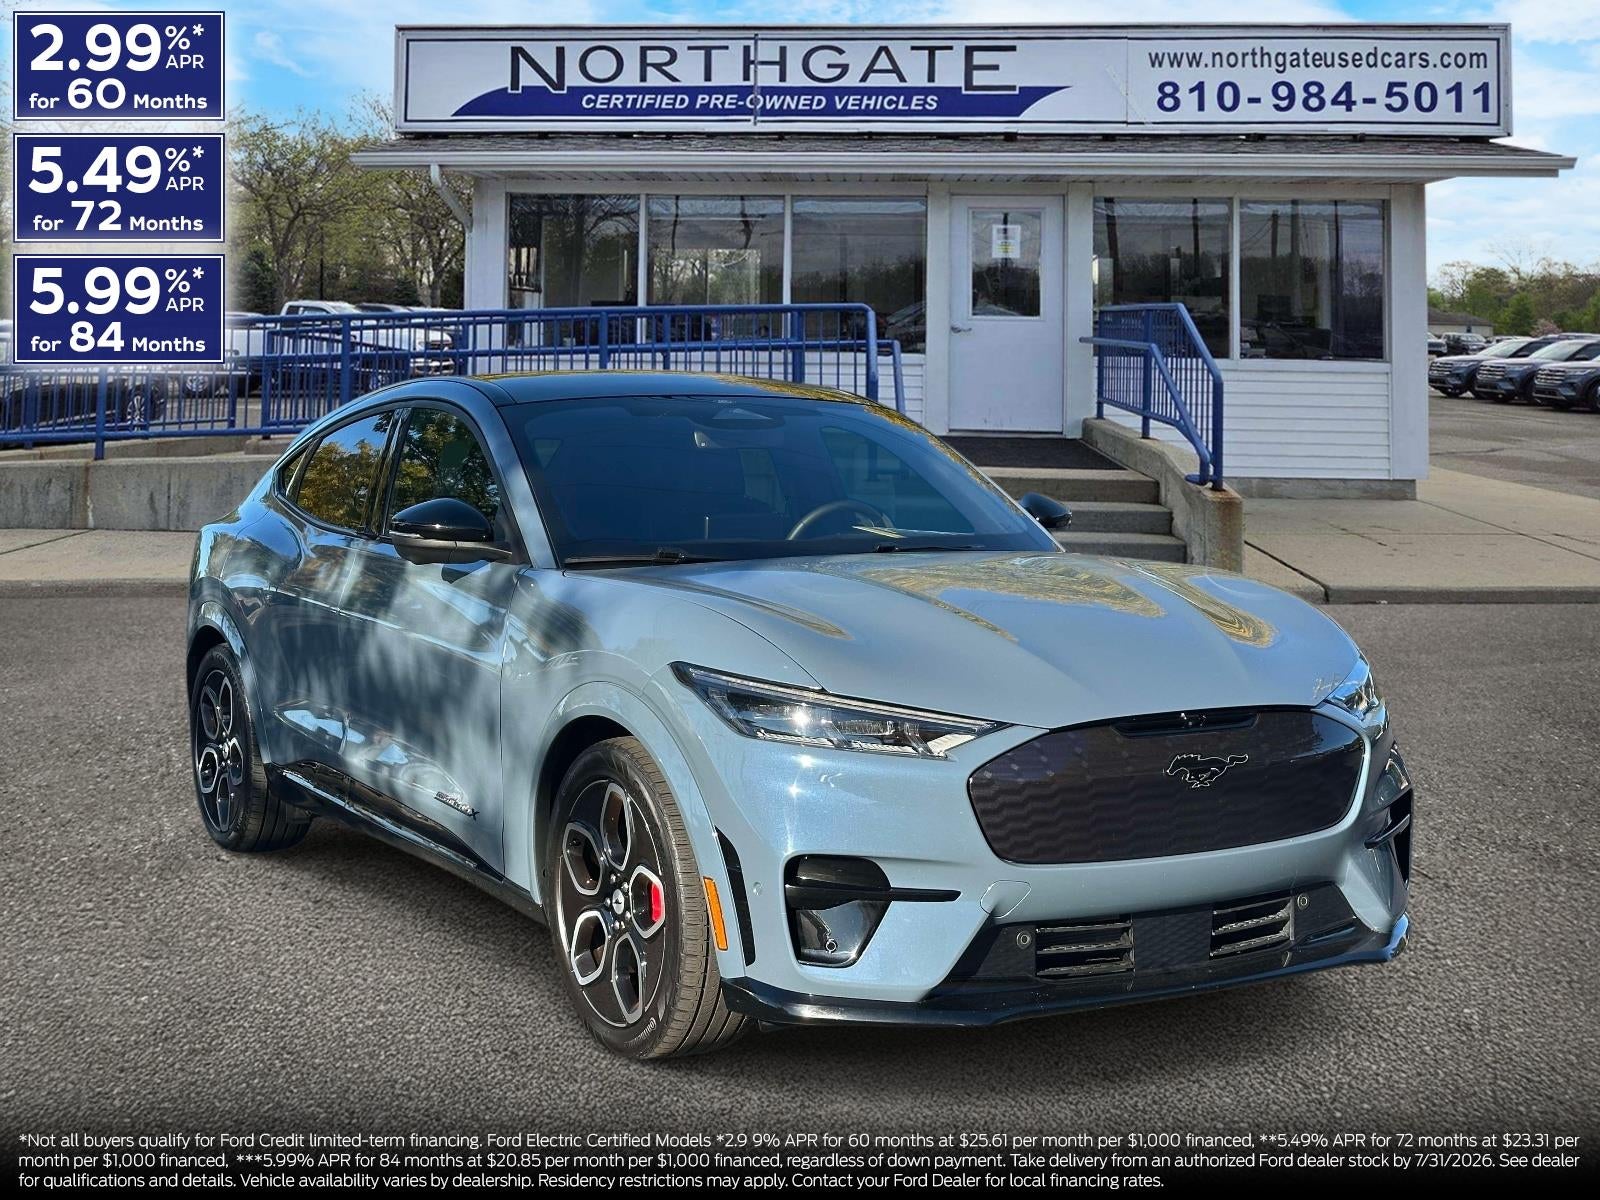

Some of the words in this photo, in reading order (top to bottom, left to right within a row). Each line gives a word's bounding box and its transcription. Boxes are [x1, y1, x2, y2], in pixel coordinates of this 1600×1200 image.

[509, 44, 1018, 92] NORTHGATE
[1148, 46, 1488, 73] www.northgateusedcars.com
[581, 94, 689, 109] CERTIFIED
[695, 94, 827, 110] PRE-OWNED
[834, 95, 939, 110] VEHICLES
[1156, 80, 1491, 113] 810-984-5011
